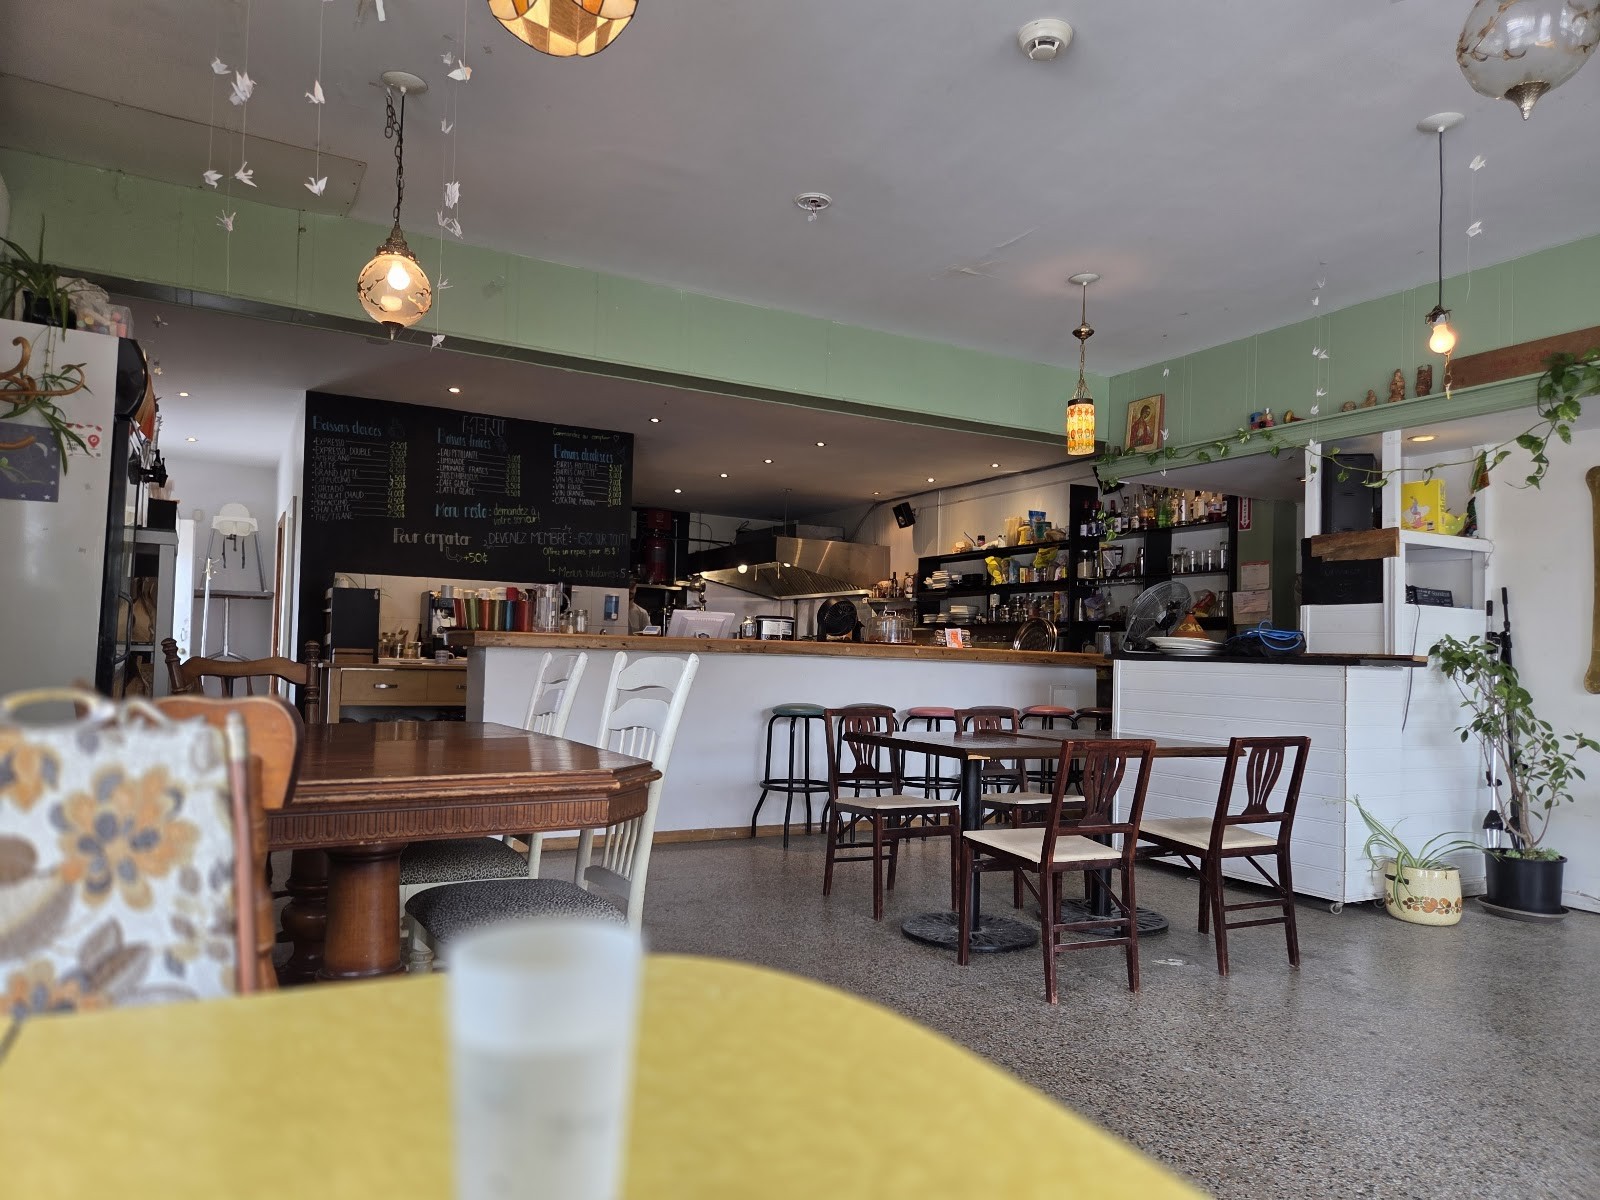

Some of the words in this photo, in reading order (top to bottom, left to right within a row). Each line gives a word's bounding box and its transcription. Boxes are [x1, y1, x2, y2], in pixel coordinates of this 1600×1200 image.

[315, 437, 345, 446] EXPRESSO
[315, 446, 345, 455] EXPRESSO
[350, 447, 371, 456] DOUBLE
[441, 457, 465, 465] LIMONADE
[568, 476, 585, 484] BLANC
[314, 491, 342, 499] CHOCOLAT
[344, 490, 364, 499] CHAUD
[435, 502, 459, 518] Menu
[494, 502, 529, 516] demandez
[494, 516, 512, 525] votre
[393, 528, 420, 544] Pour
[424, 532, 472, 552] emporter
[489, 532, 527, 544] DEVENEZ
[595, 533, 606, 545] SUR
[589, 549, 600, 558] pour
[463, 552, 489, 566] +50¢
[559, 565, 582, 578] Menus
